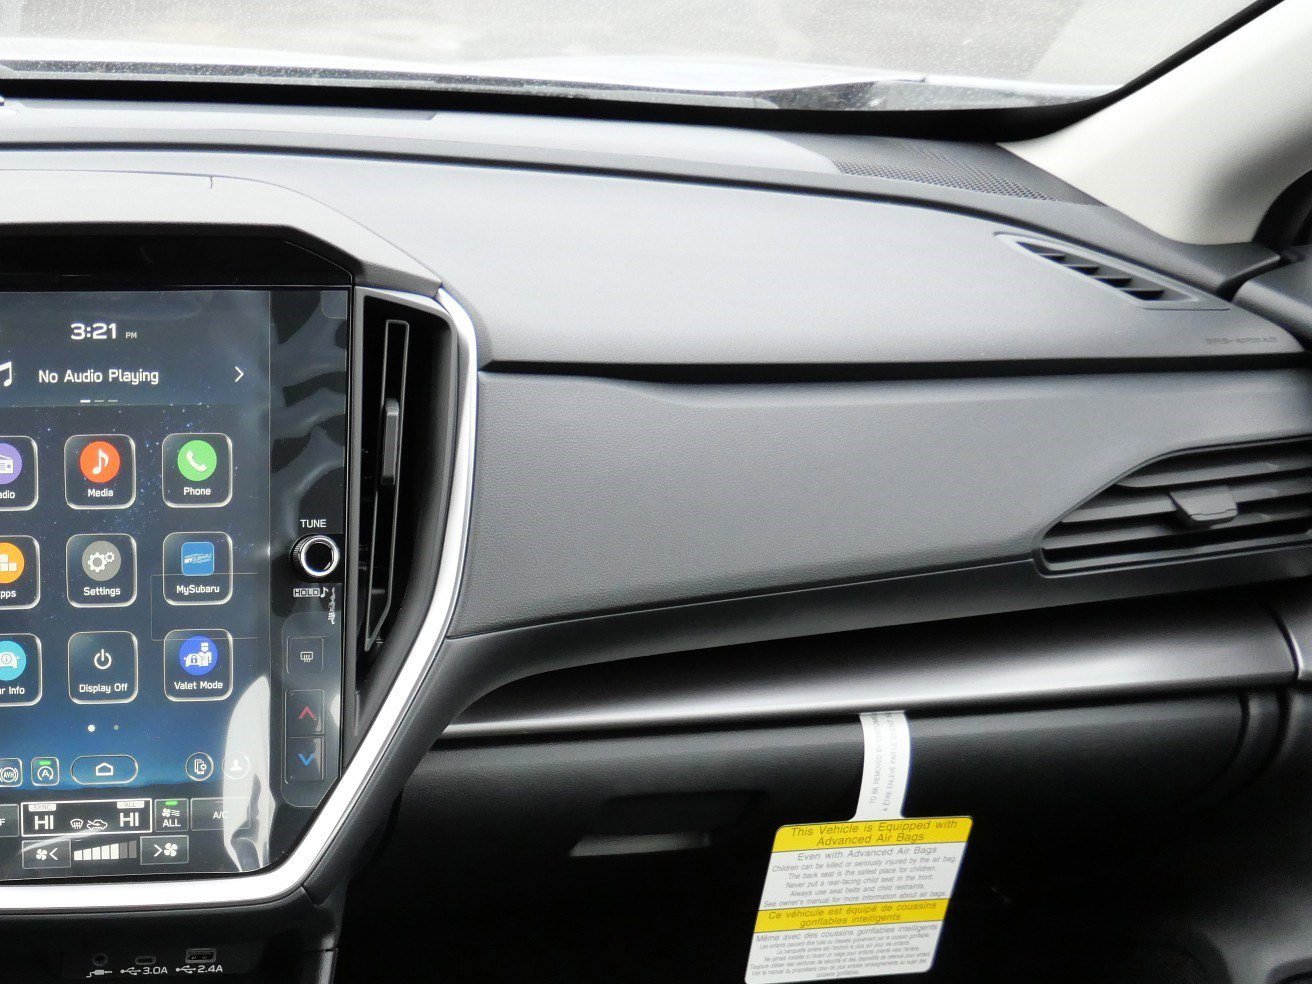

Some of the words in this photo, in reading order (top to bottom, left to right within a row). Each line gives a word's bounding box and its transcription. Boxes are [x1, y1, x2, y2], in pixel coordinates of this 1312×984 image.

[70, 323, 117, 340] 3:21
[38, 370, 58, 383] No
[64, 369, 103, 383] Audio
[108, 368, 159, 385] Playing
[87, 488, 114, 497] Media
[183, 487, 211, 496] Phone
[300, 519, 327, 528] TUNE
[83, 587, 121, 597] Settings
[176, 585, 220, 595] MySubaru
[293, 588, 320, 597] HOLD
[8, 686, 25, 695] Info
[79, 684, 111, 694] Display
[114, 683, 128, 692] Off
[174, 682, 197, 690] Valet
[200, 681, 223, 689] Mode
[34, 815, 54, 830] HI
[119, 812, 140, 827] HI
[162, 819, 181, 827] ALL
[791, 827, 814, 837] This
[819, 825, 859, 835] Vehicle
[863, 823, 873, 832] is
[878, 820, 930, 832] Equipped
[935, 820, 957, 829] with
[816, 835, 872, 846] Advanced
[876, 833, 892, 842] Air
[896, 832, 924, 843] Bags
[797, 852, 821, 860] Even
[825, 851, 843, 859] with
[847, 848, 893, 857] Advanced
[897, 847, 911, 855] Air
[913, 846, 937, 855] Bags
[768, 911, 782, 920] Ce
[828, 907, 843, 916] est
[896, 902, 937, 911] coussins
[851, 913, 901, 924] intelligents
[142, 967, 168, 975] 3.0A
[197, 965, 223, 973] 2.4A
